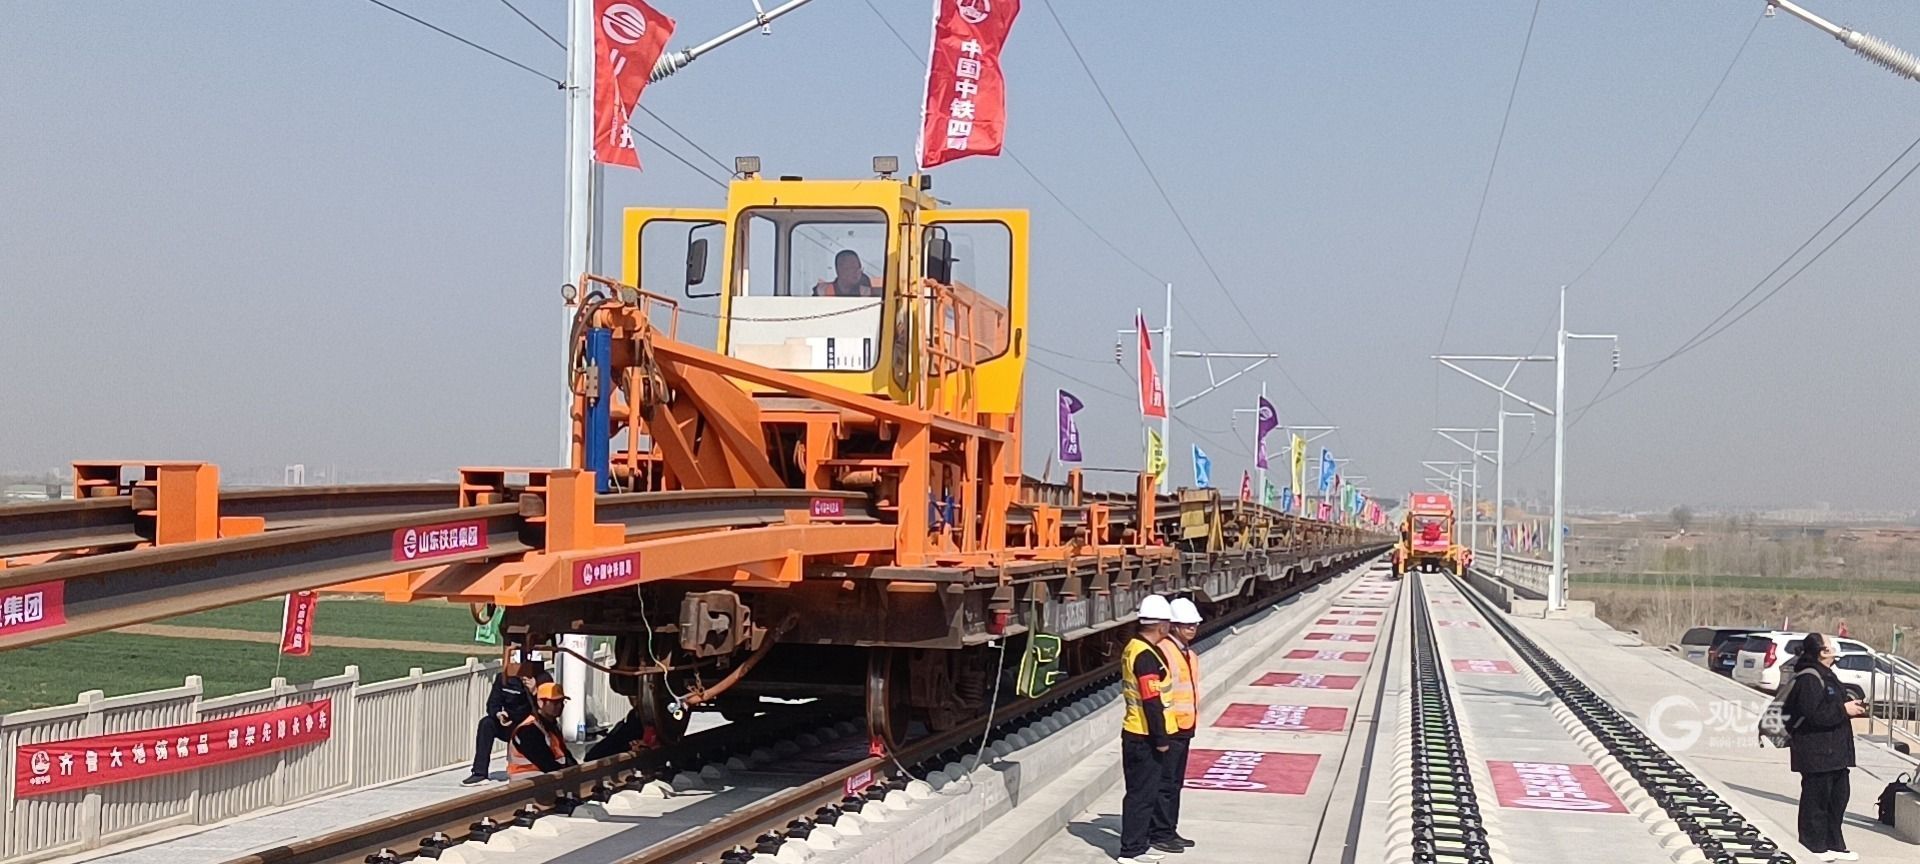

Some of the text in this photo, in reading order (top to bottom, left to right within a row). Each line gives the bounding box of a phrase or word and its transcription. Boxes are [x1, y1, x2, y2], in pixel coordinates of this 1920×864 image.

[418, 525, 478, 553] 山东铁投集团
[0, 591, 43, 627] 集团
